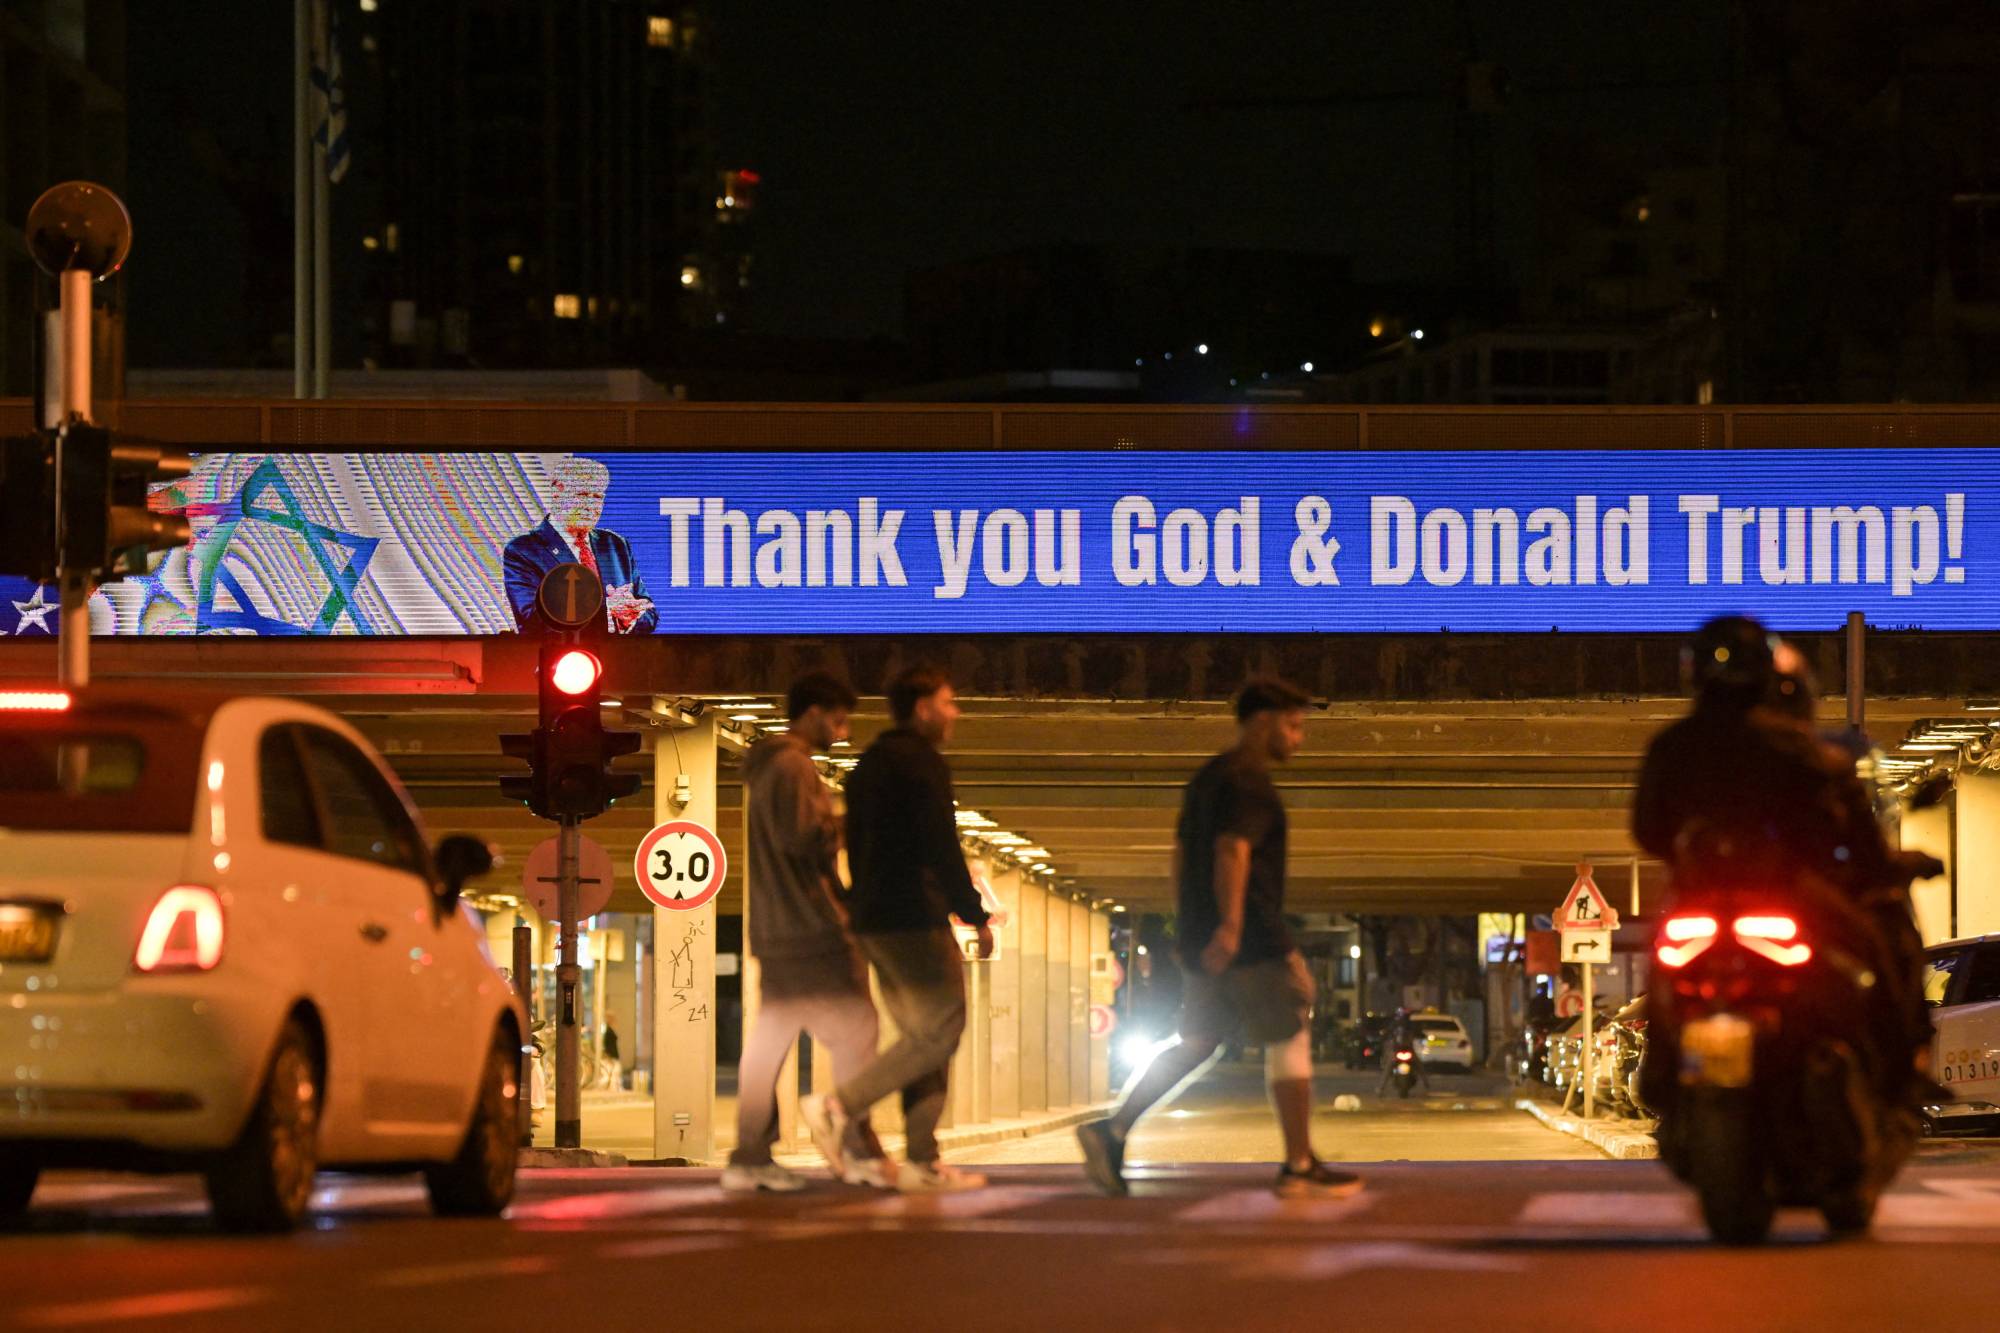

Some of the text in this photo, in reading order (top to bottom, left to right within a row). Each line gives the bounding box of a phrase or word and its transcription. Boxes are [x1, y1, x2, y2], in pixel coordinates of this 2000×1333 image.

[659, 493, 1966, 599] Thank you God & Donald Trump!
[652, 849, 709, 883] 3.0
